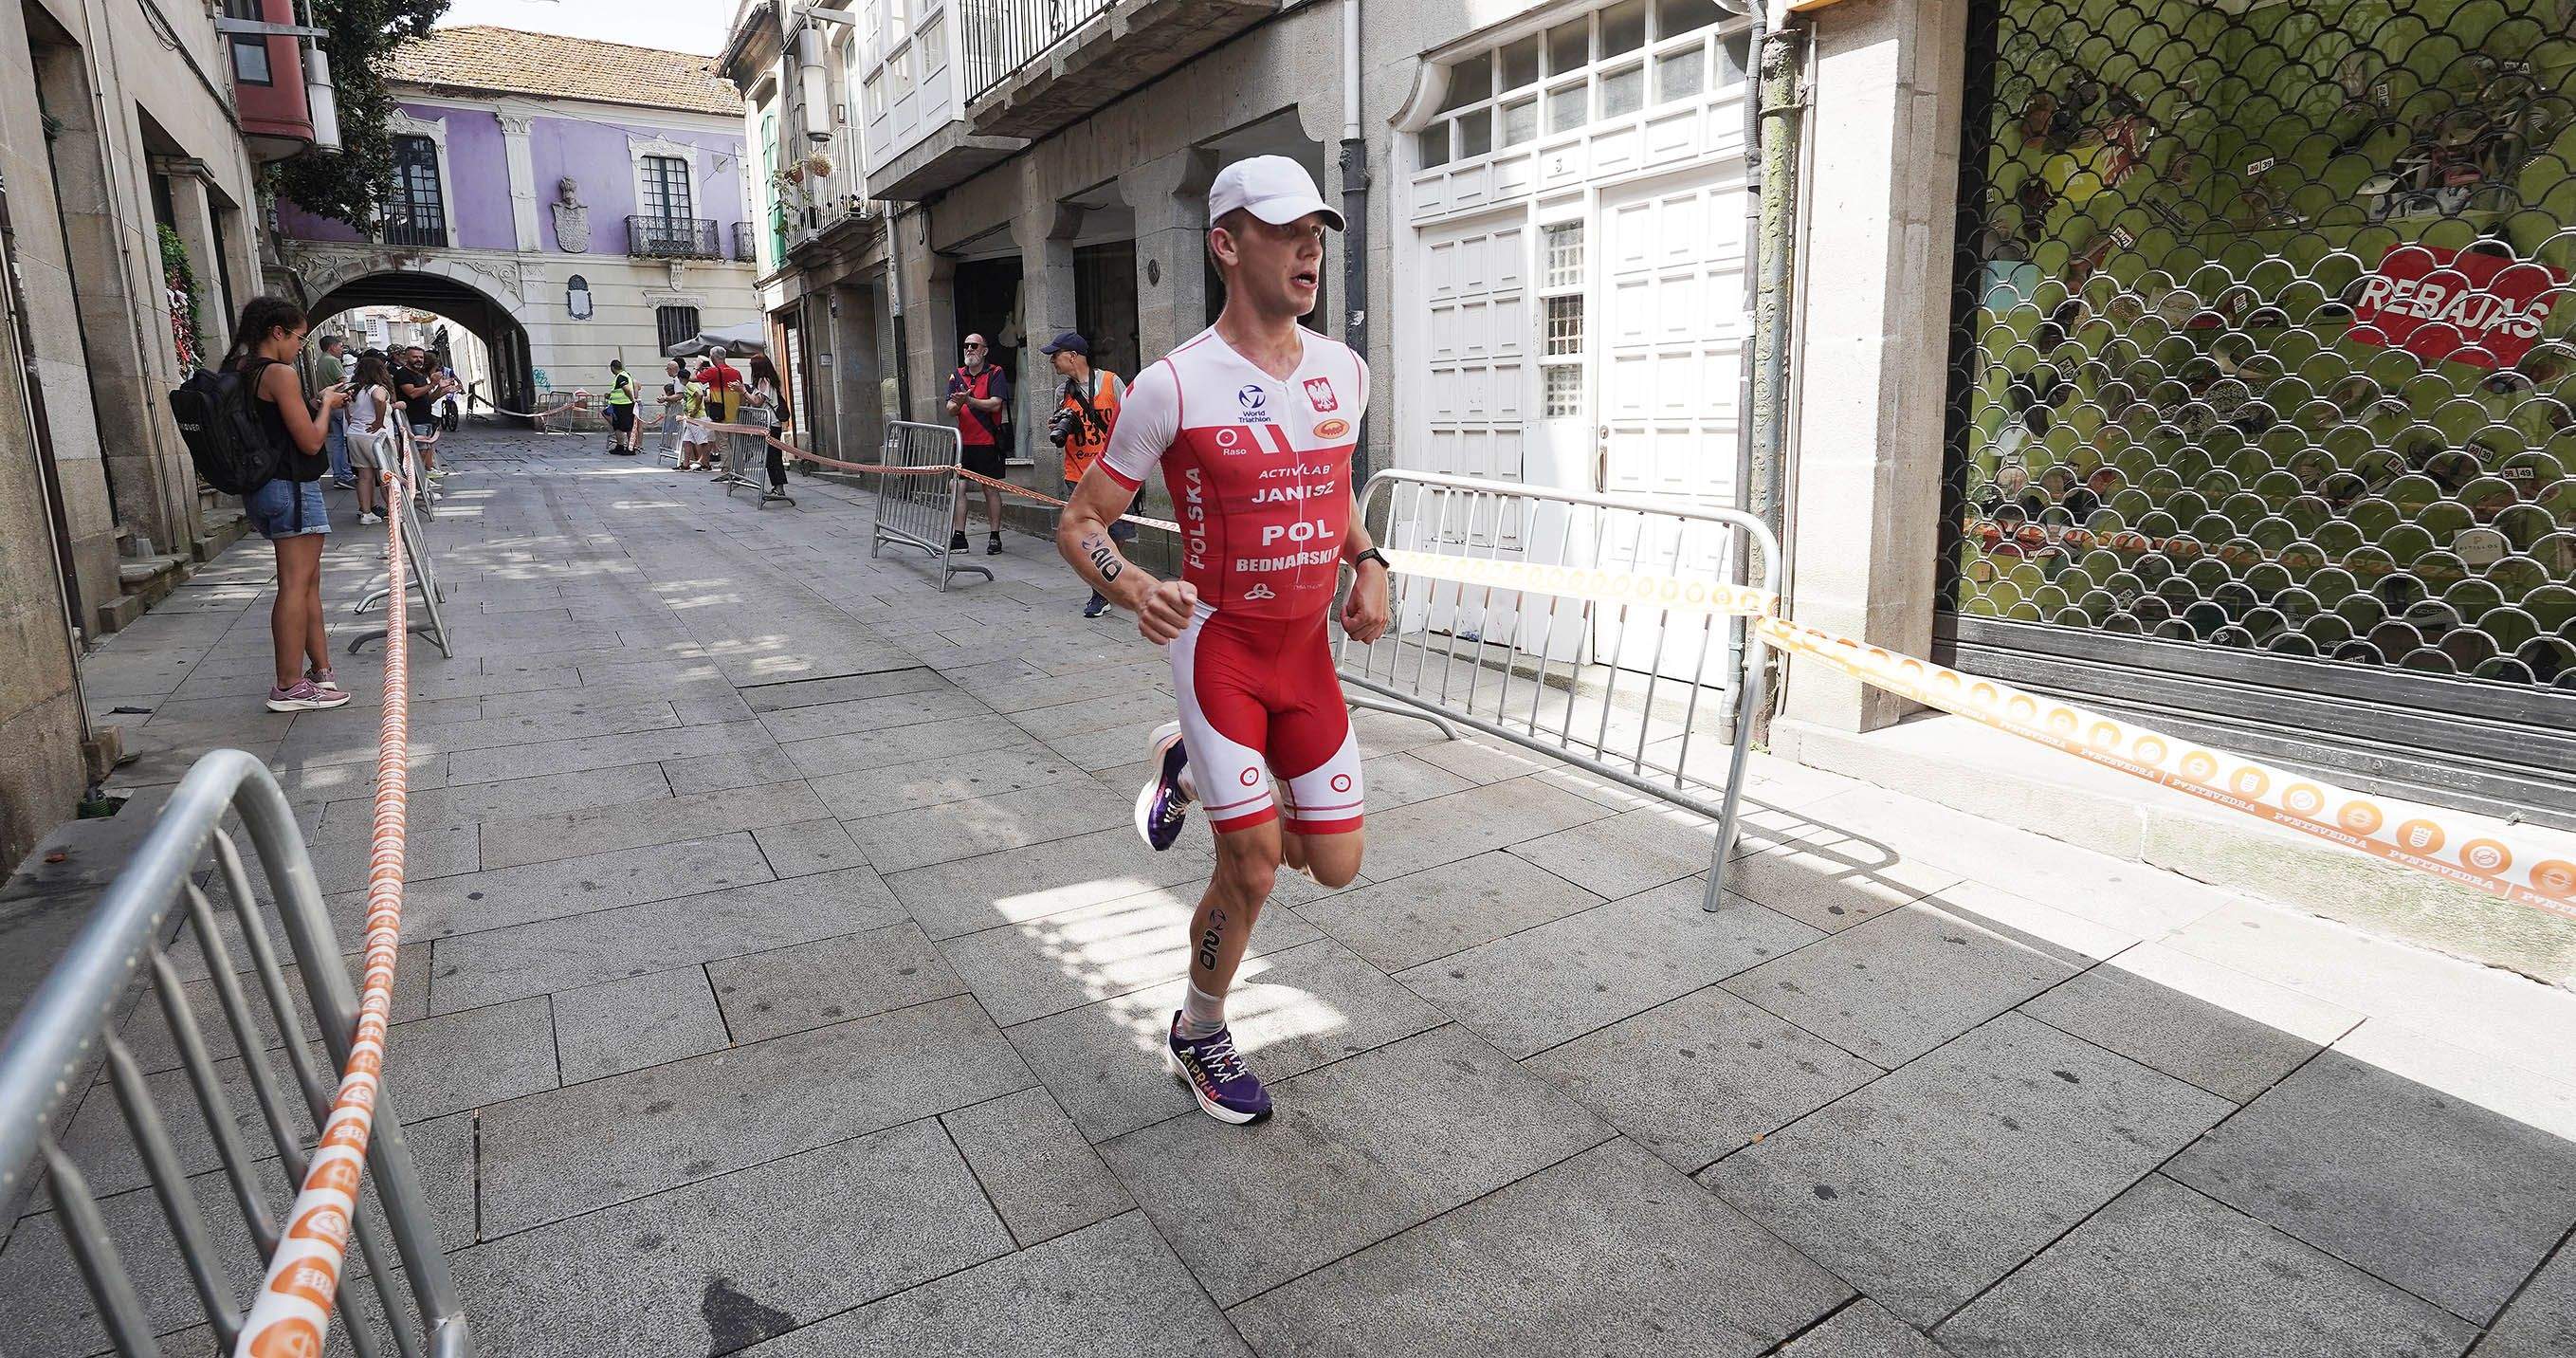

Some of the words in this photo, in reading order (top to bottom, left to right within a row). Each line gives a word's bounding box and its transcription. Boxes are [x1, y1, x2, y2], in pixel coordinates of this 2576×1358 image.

[2358, 278, 2549, 339] REBAJAS
[1237, 415, 1271, 424] Triathlon
[2480, 449, 2491, 459] 39
[1258, 464, 1331, 479] ACTIVLAB
[2519, 468, 2531, 477] 49
[1251, 480, 1335, 504] JANISZ
[1185, 468, 1207, 570] POLSKA
[1262, 519, 1334, 546] POL
[1199, 928, 1221, 971] 20
